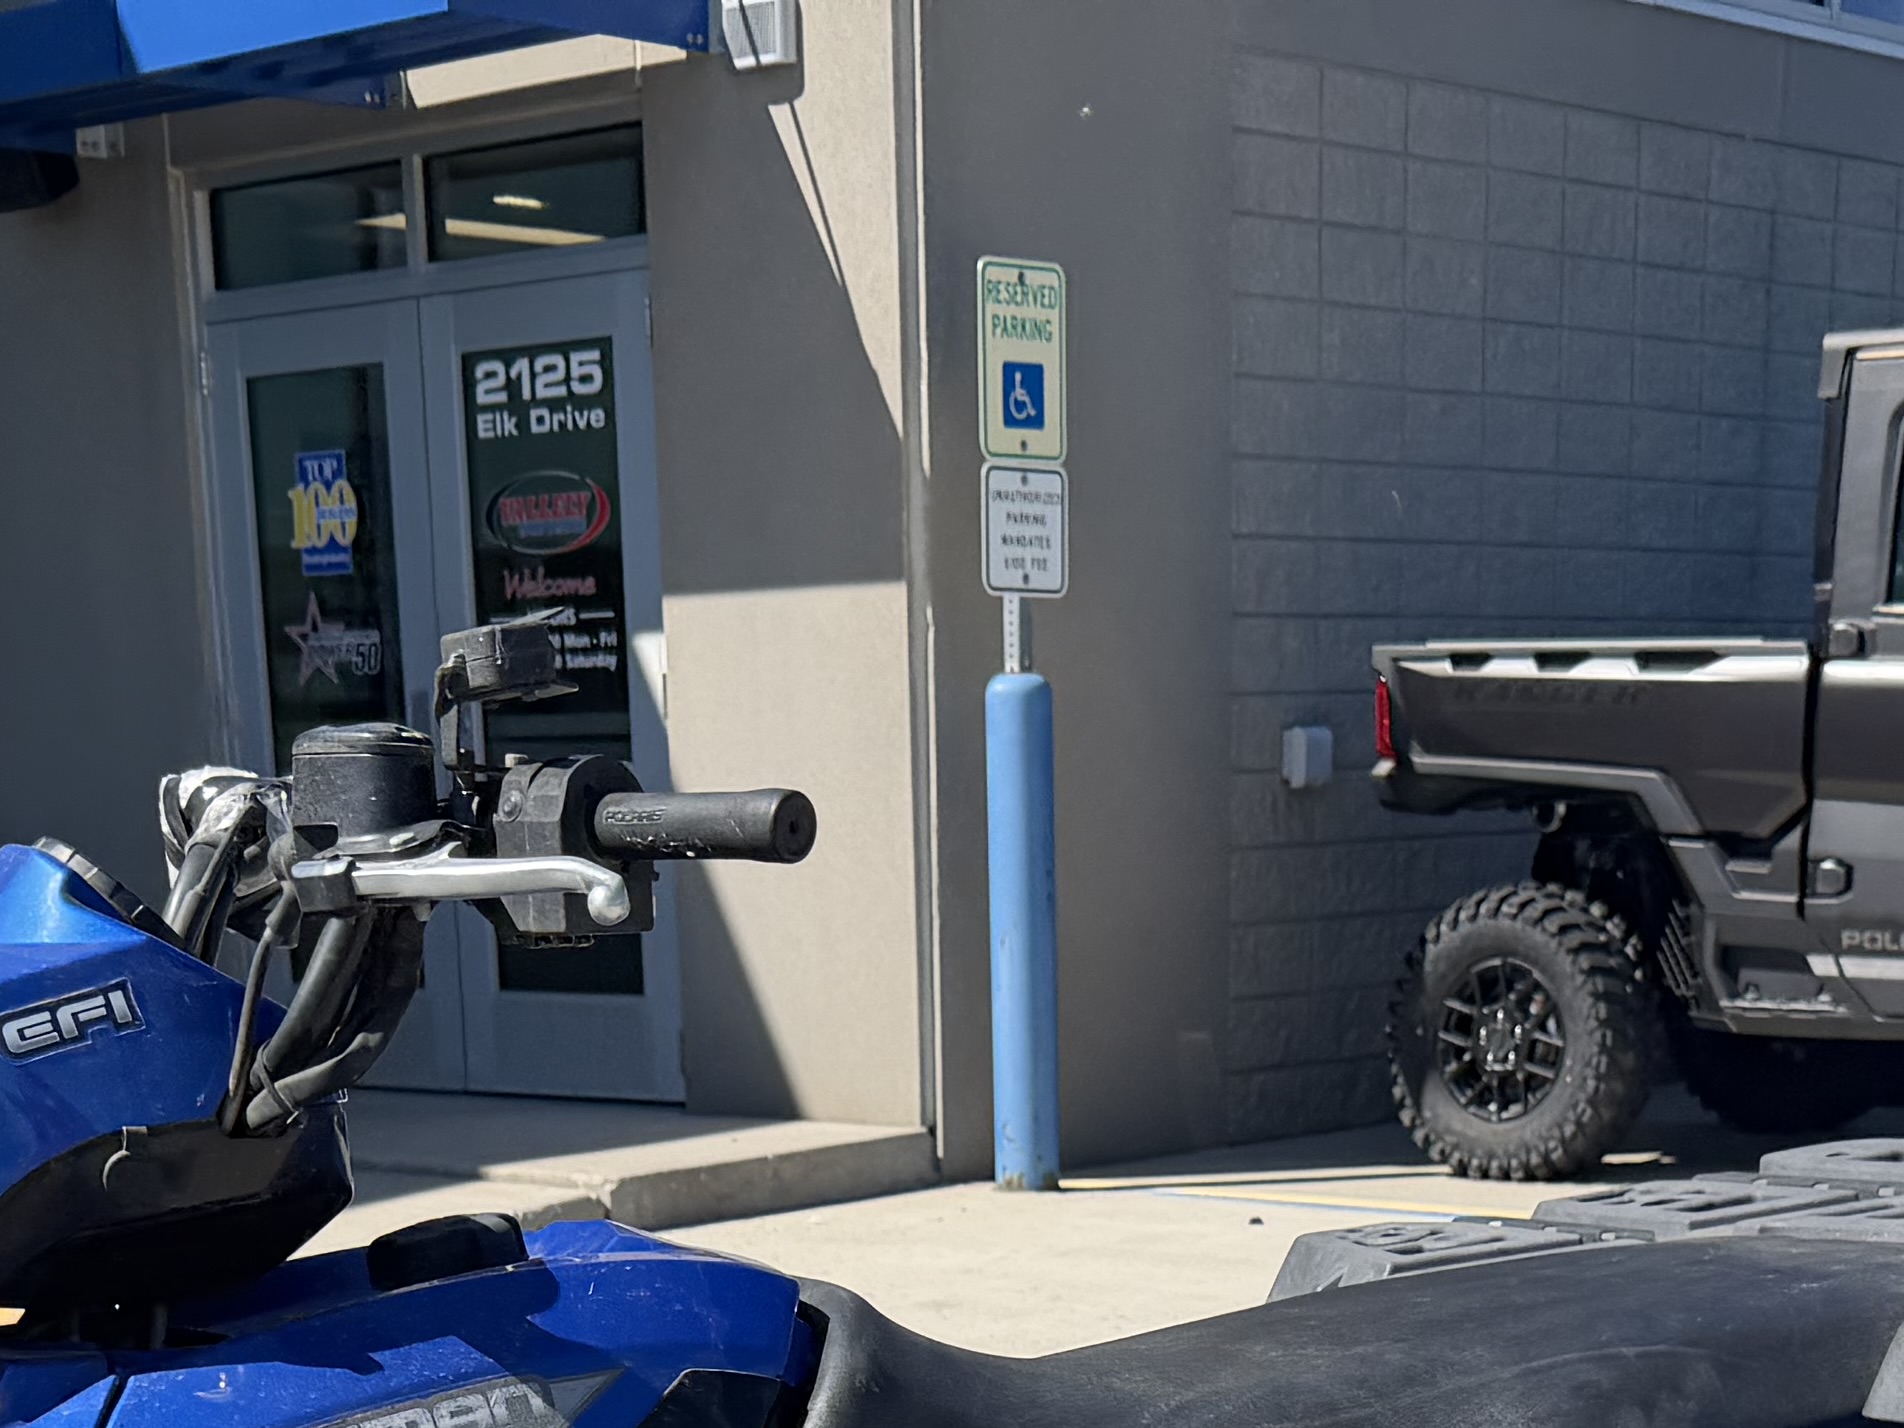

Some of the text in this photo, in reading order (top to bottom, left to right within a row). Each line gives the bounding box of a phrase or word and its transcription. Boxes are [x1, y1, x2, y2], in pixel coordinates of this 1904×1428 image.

[986, 279, 1057, 310] RESERVED
[992, 314, 1052, 343] PARKING
[475, 349, 603, 405] 2125
[476, 404, 606, 439] Elk Drive
[303, 459, 338, 483] TOP
[288, 479, 358, 549] 100
[503, 565, 596, 600] Welcome
[353, 641, 381, 675] 50
[2, 990, 132, 1055] EFI
